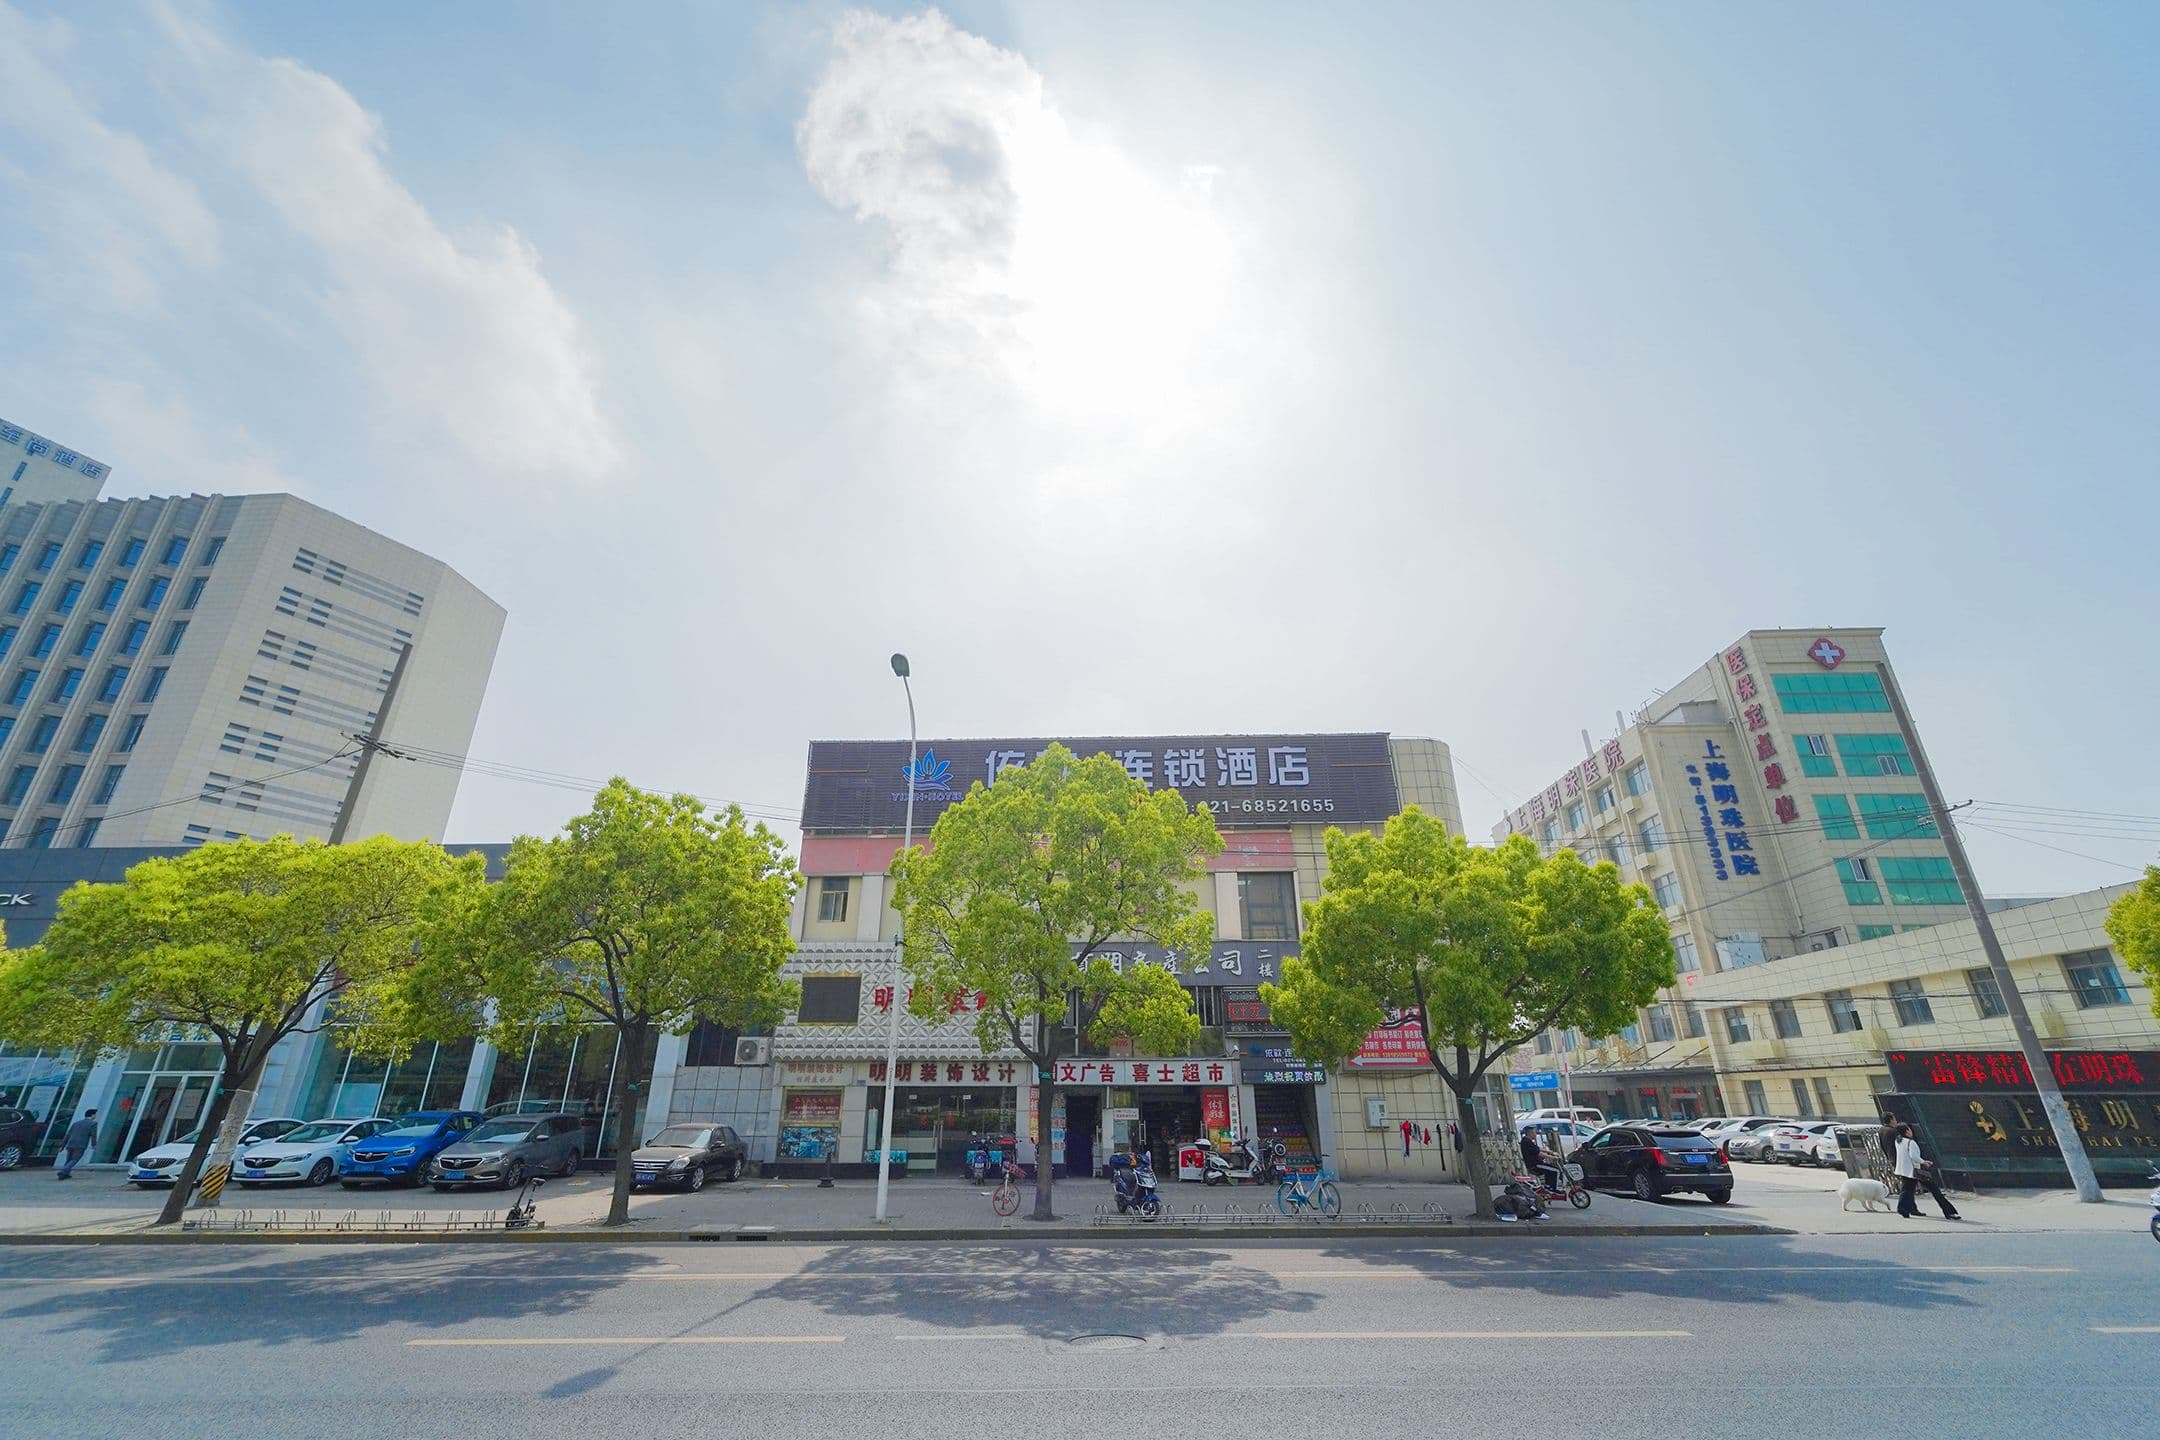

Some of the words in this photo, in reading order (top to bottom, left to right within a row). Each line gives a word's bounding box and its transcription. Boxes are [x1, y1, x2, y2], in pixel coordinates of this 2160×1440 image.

[1517, 739, 1625, 829] 上海明珠医院
[1702, 739, 1760, 876] 上海明珠医院
[869, 1063, 1016, 1083] 明明装饰设计
[1053, 1062, 1116, 1083] 文广告
[1132, 1062, 1225, 1083] 喜士超市
